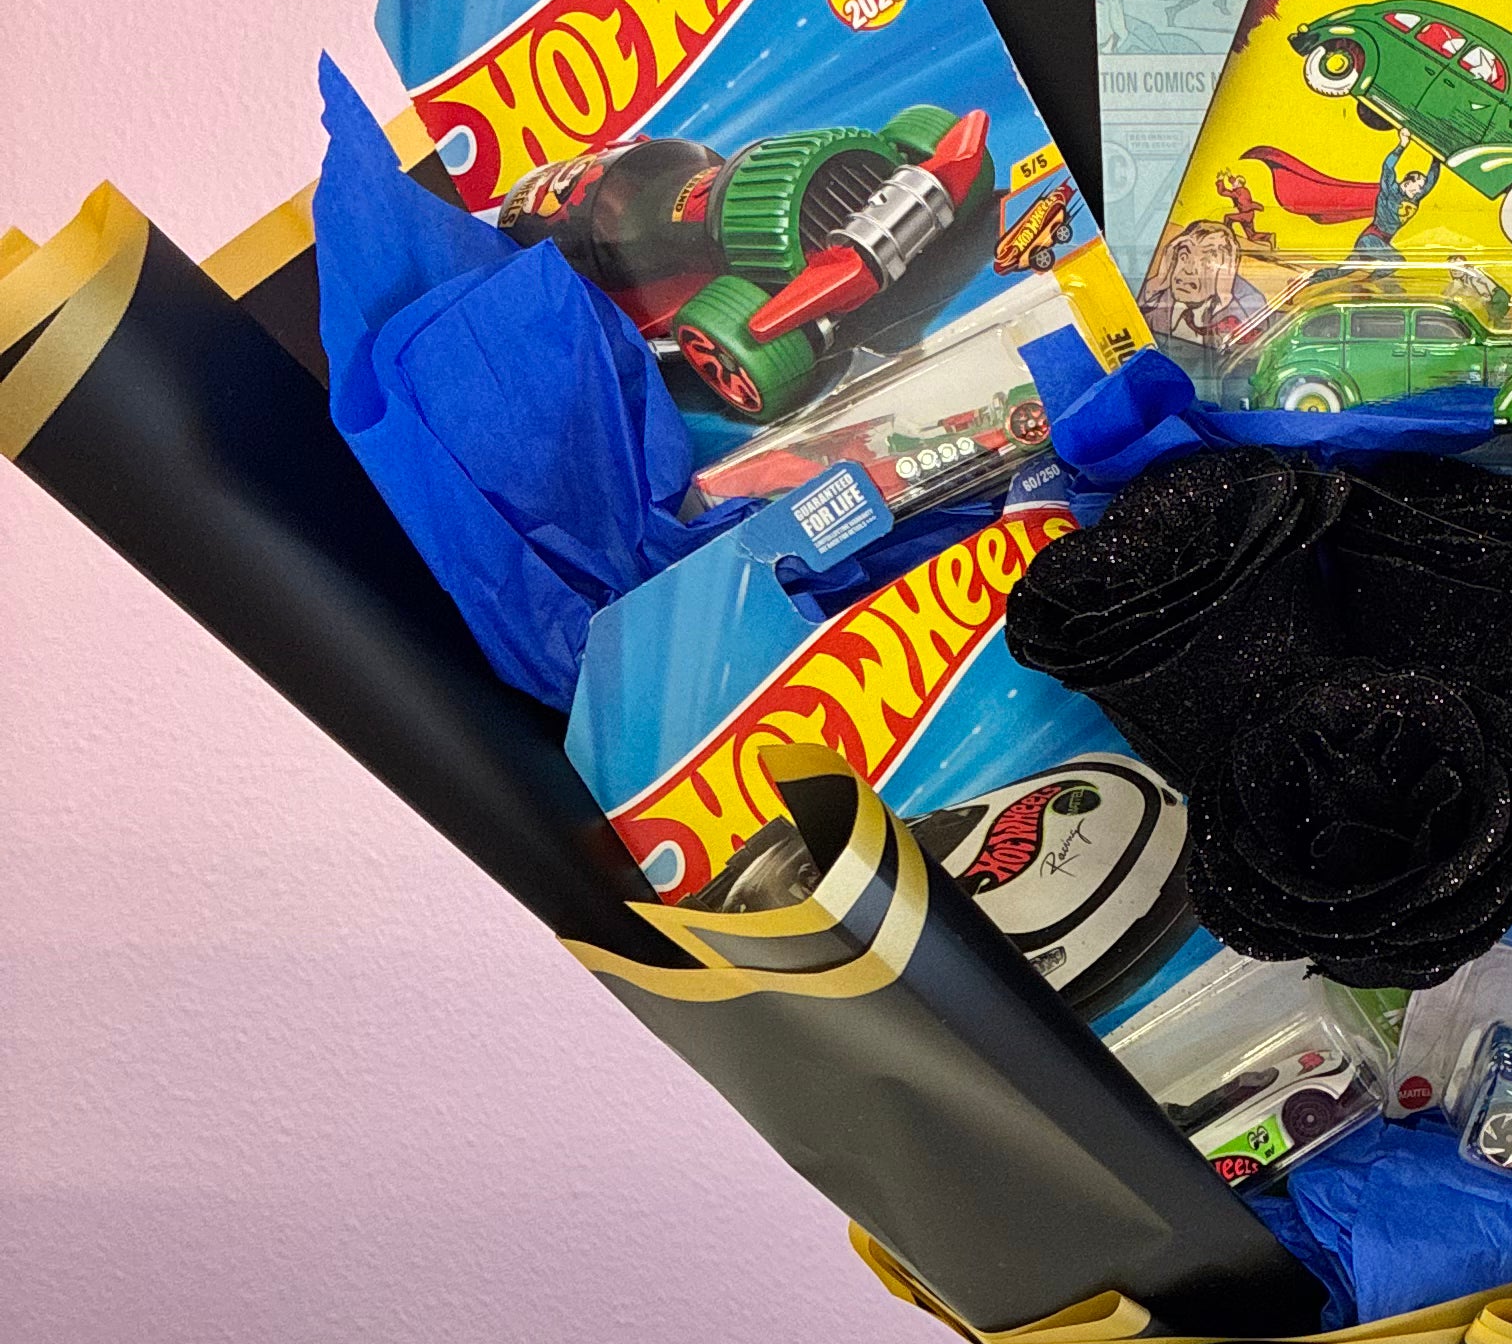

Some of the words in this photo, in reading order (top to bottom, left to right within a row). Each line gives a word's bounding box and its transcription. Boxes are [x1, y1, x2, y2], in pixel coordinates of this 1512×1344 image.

[1101, 71, 1138, 93] TION
[1143, 71, 1205, 93] COMICS
[1020, 154, 1048, 178] 5/5
[1022, 464, 1060, 492] 60/250
[794, 473, 854, 522] GUARANTEED
[800, 506, 836, 538] FOR
[829, 484, 865, 517] LIFE
